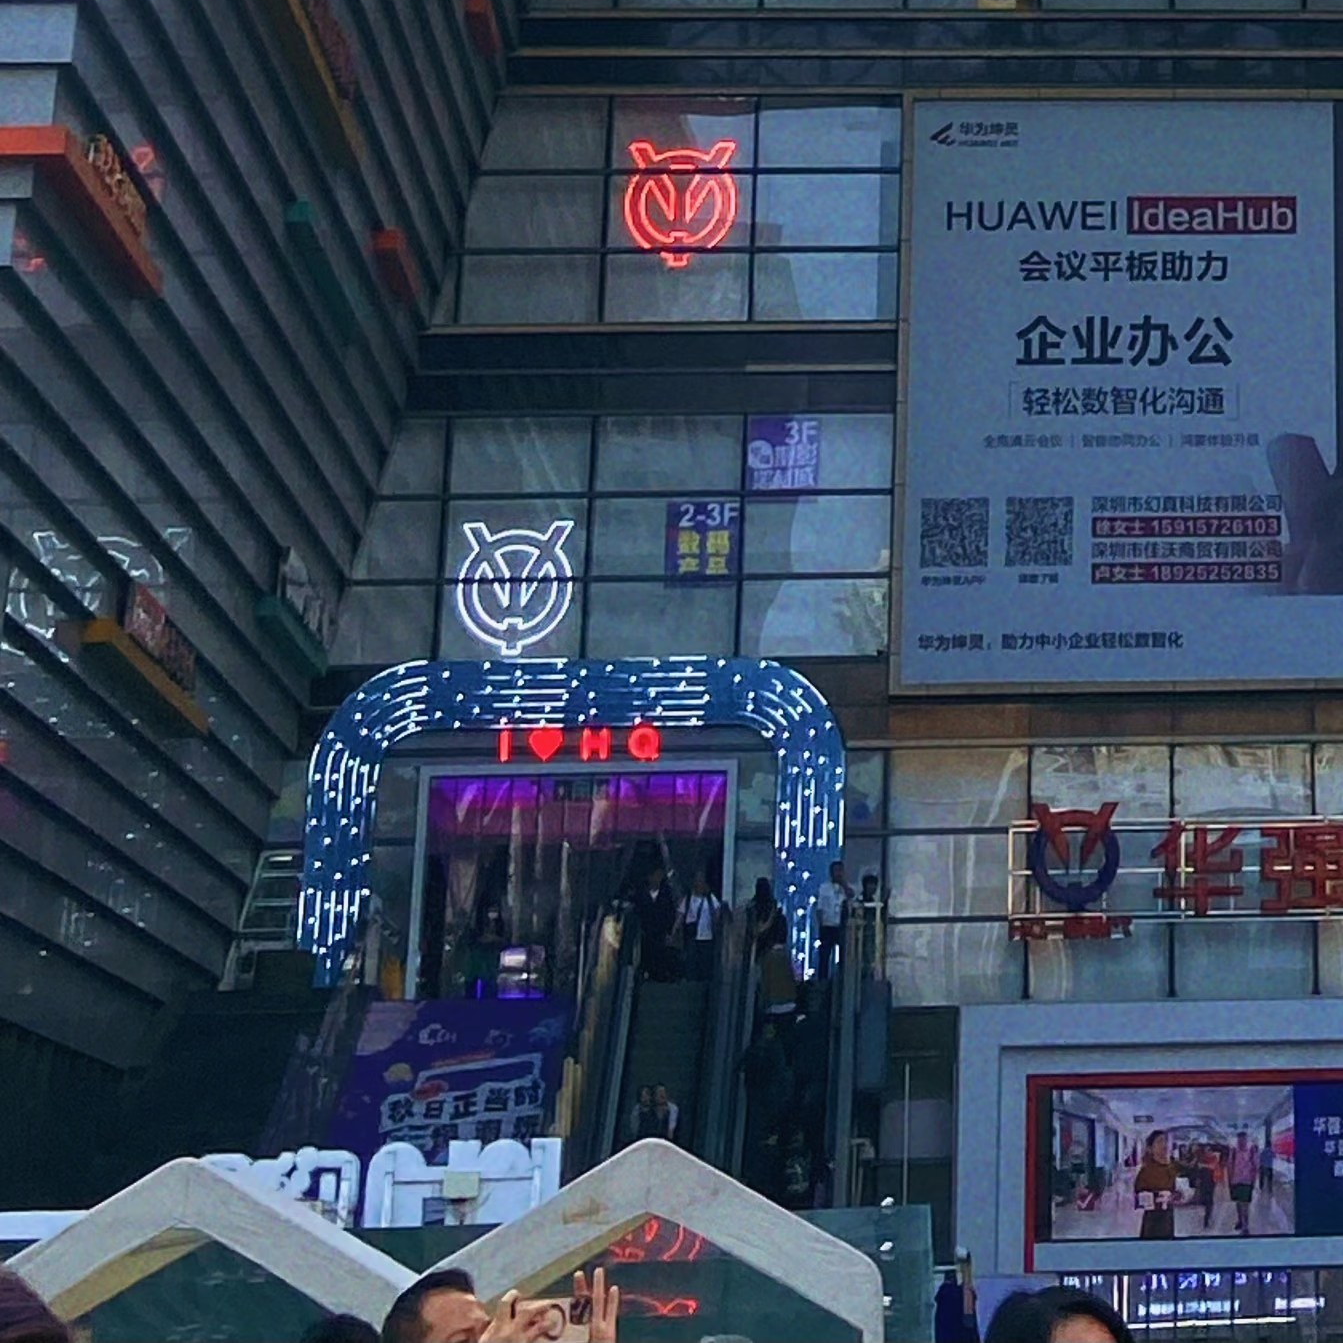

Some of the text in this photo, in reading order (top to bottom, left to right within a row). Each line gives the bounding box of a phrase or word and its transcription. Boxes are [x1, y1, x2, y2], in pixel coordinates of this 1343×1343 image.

[945, 194, 1294, 232] HUAWEI IdeaHub
[1018, 249, 1230, 284] 会议平板助力
[1014, 314, 1235, 367] 企业办公
[1021, 385, 1226, 417] 轻松数智化沟通
[784, 420, 819, 445] 3F
[678, 503, 740, 527] 2-3F
